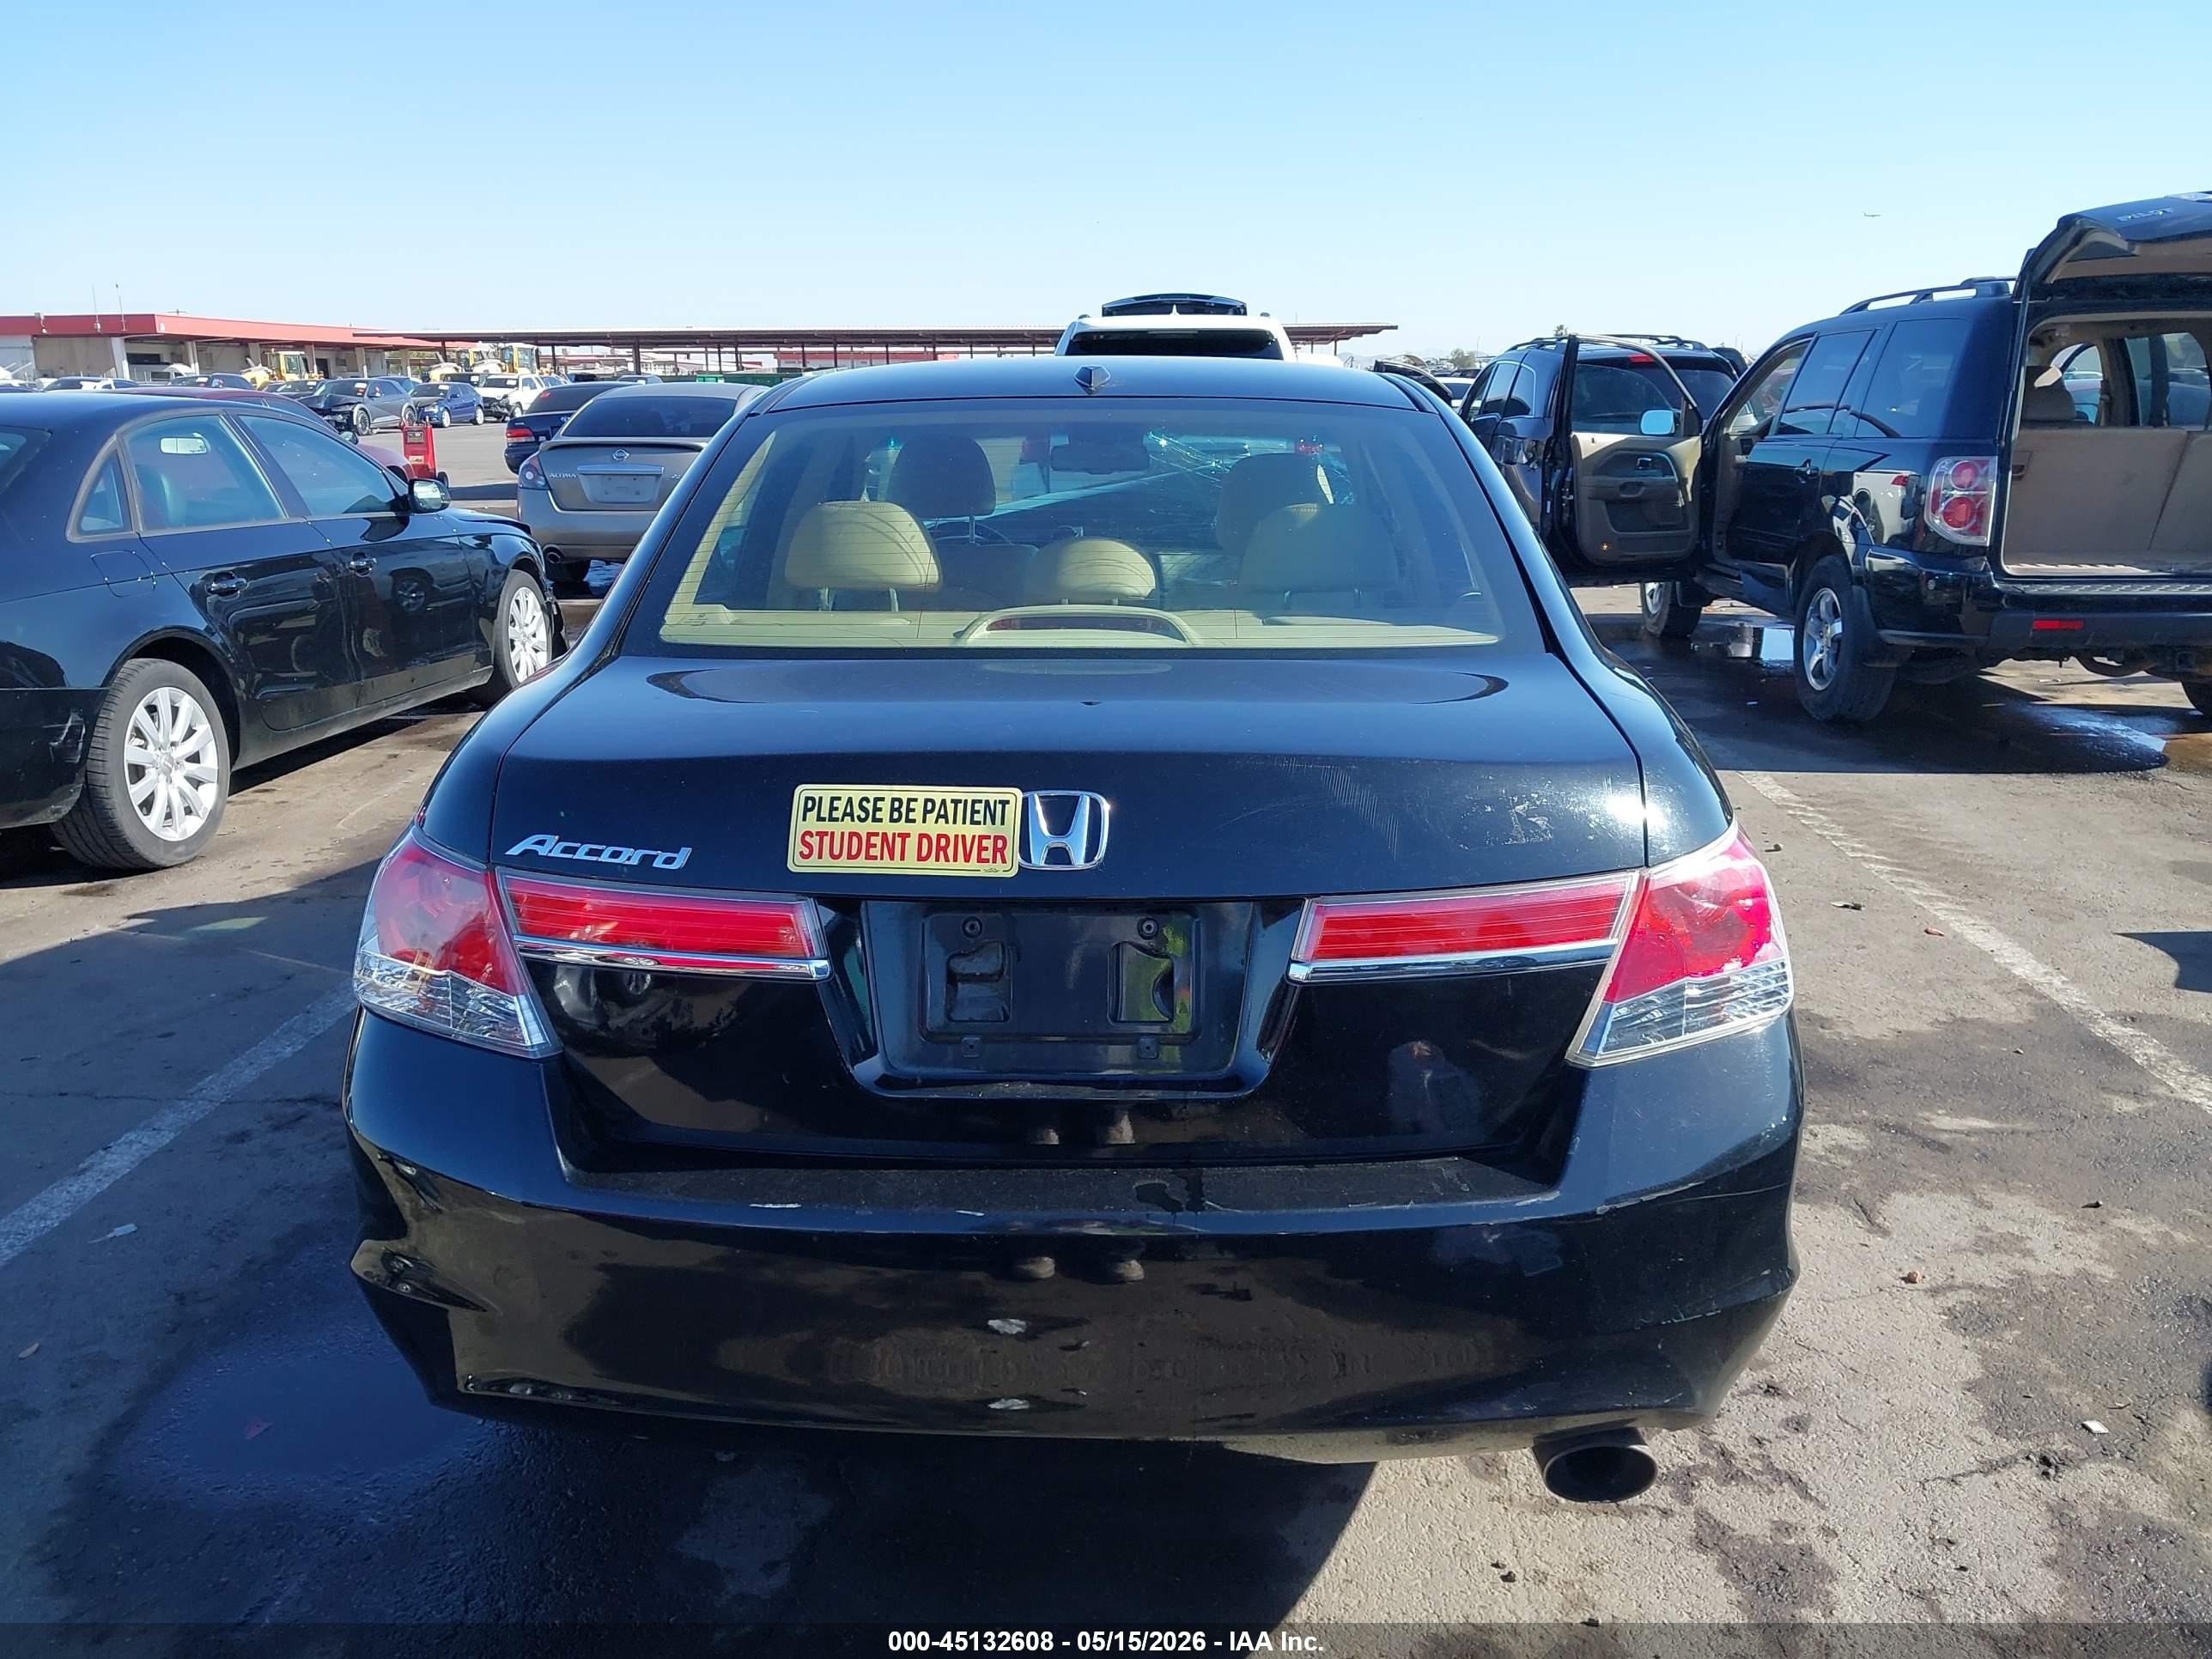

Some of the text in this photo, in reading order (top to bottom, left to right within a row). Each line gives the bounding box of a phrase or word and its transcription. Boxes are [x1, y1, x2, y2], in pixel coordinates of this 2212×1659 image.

[802, 795, 1011, 826] PLEASE BE PATIENT
[505, 834, 692, 870] Accord
[799, 830, 1007, 865] STUDENT DRIVER
